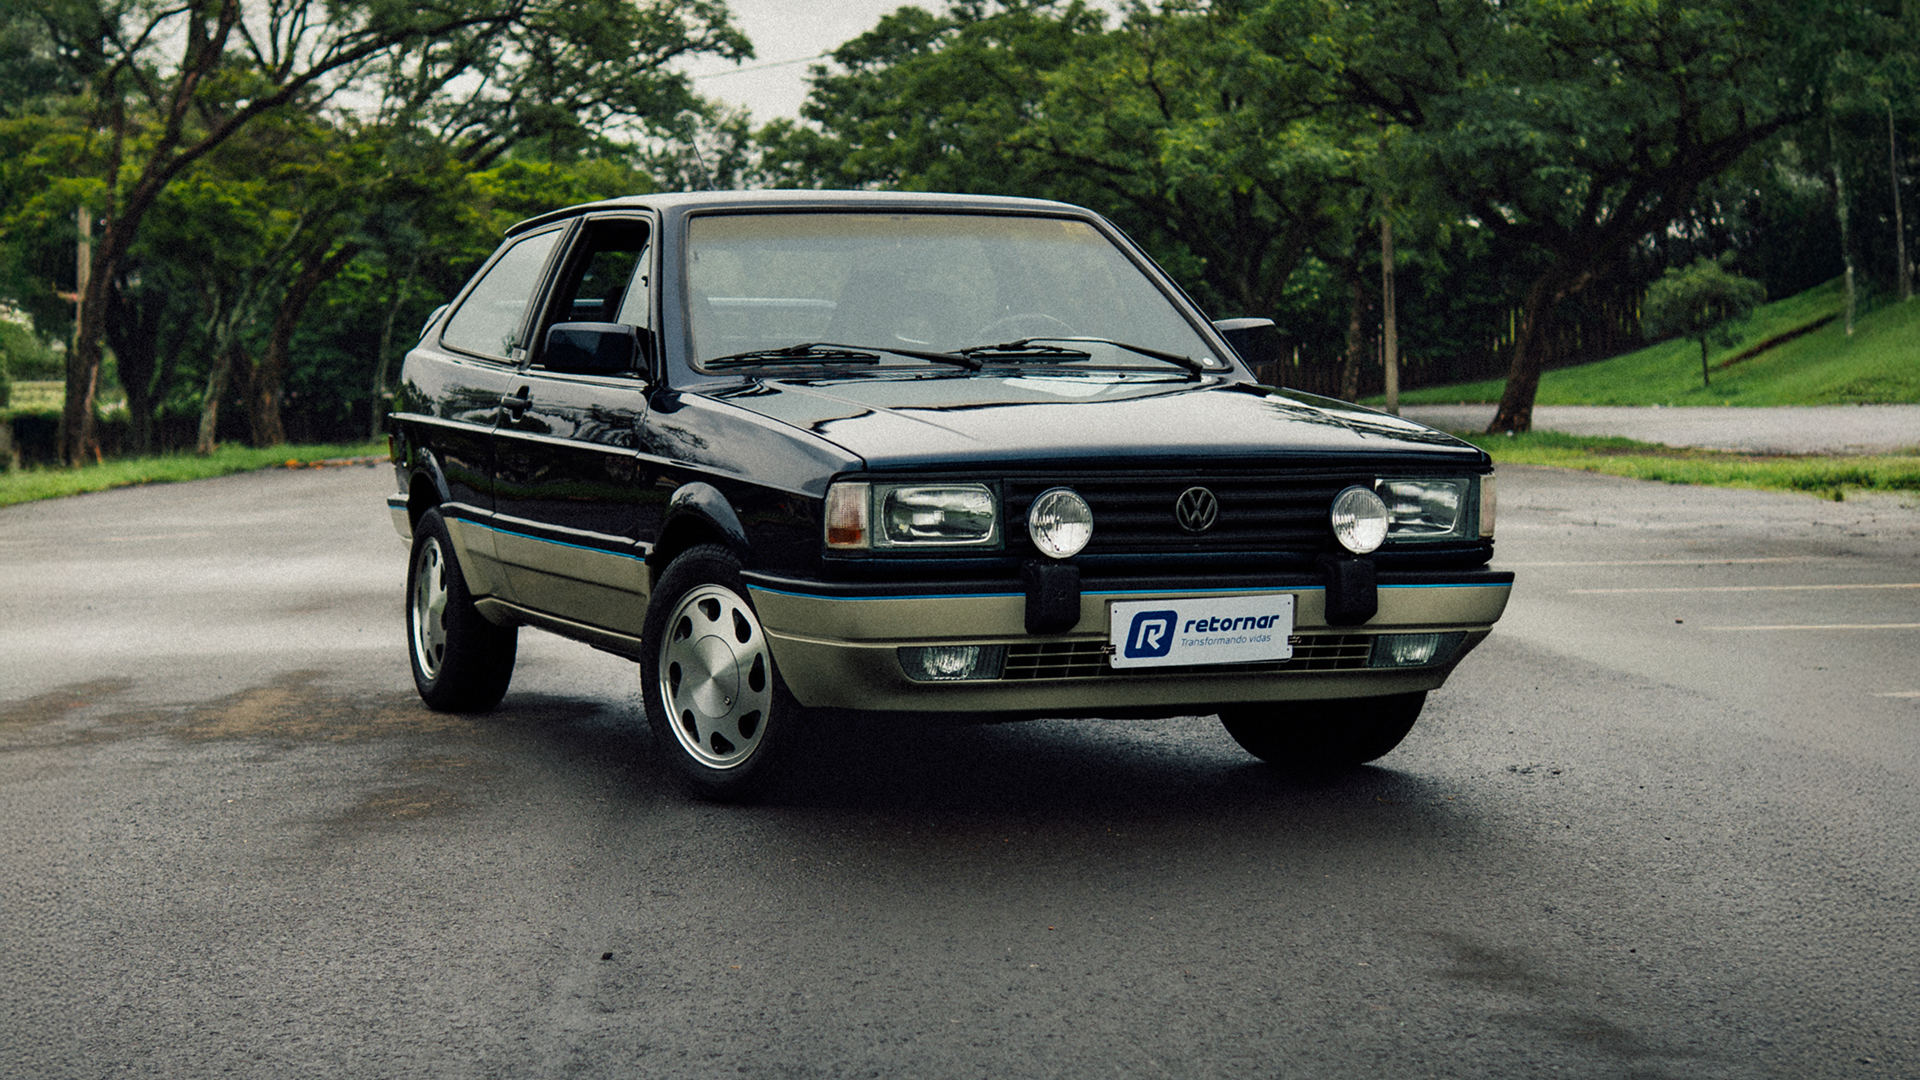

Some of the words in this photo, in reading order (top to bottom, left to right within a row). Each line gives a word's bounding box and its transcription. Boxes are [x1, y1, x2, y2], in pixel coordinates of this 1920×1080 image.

[1184, 615, 1280, 633] retornar
[1181, 636, 1247, 647] Transformando
[1250, 634, 1271, 643] vidas
